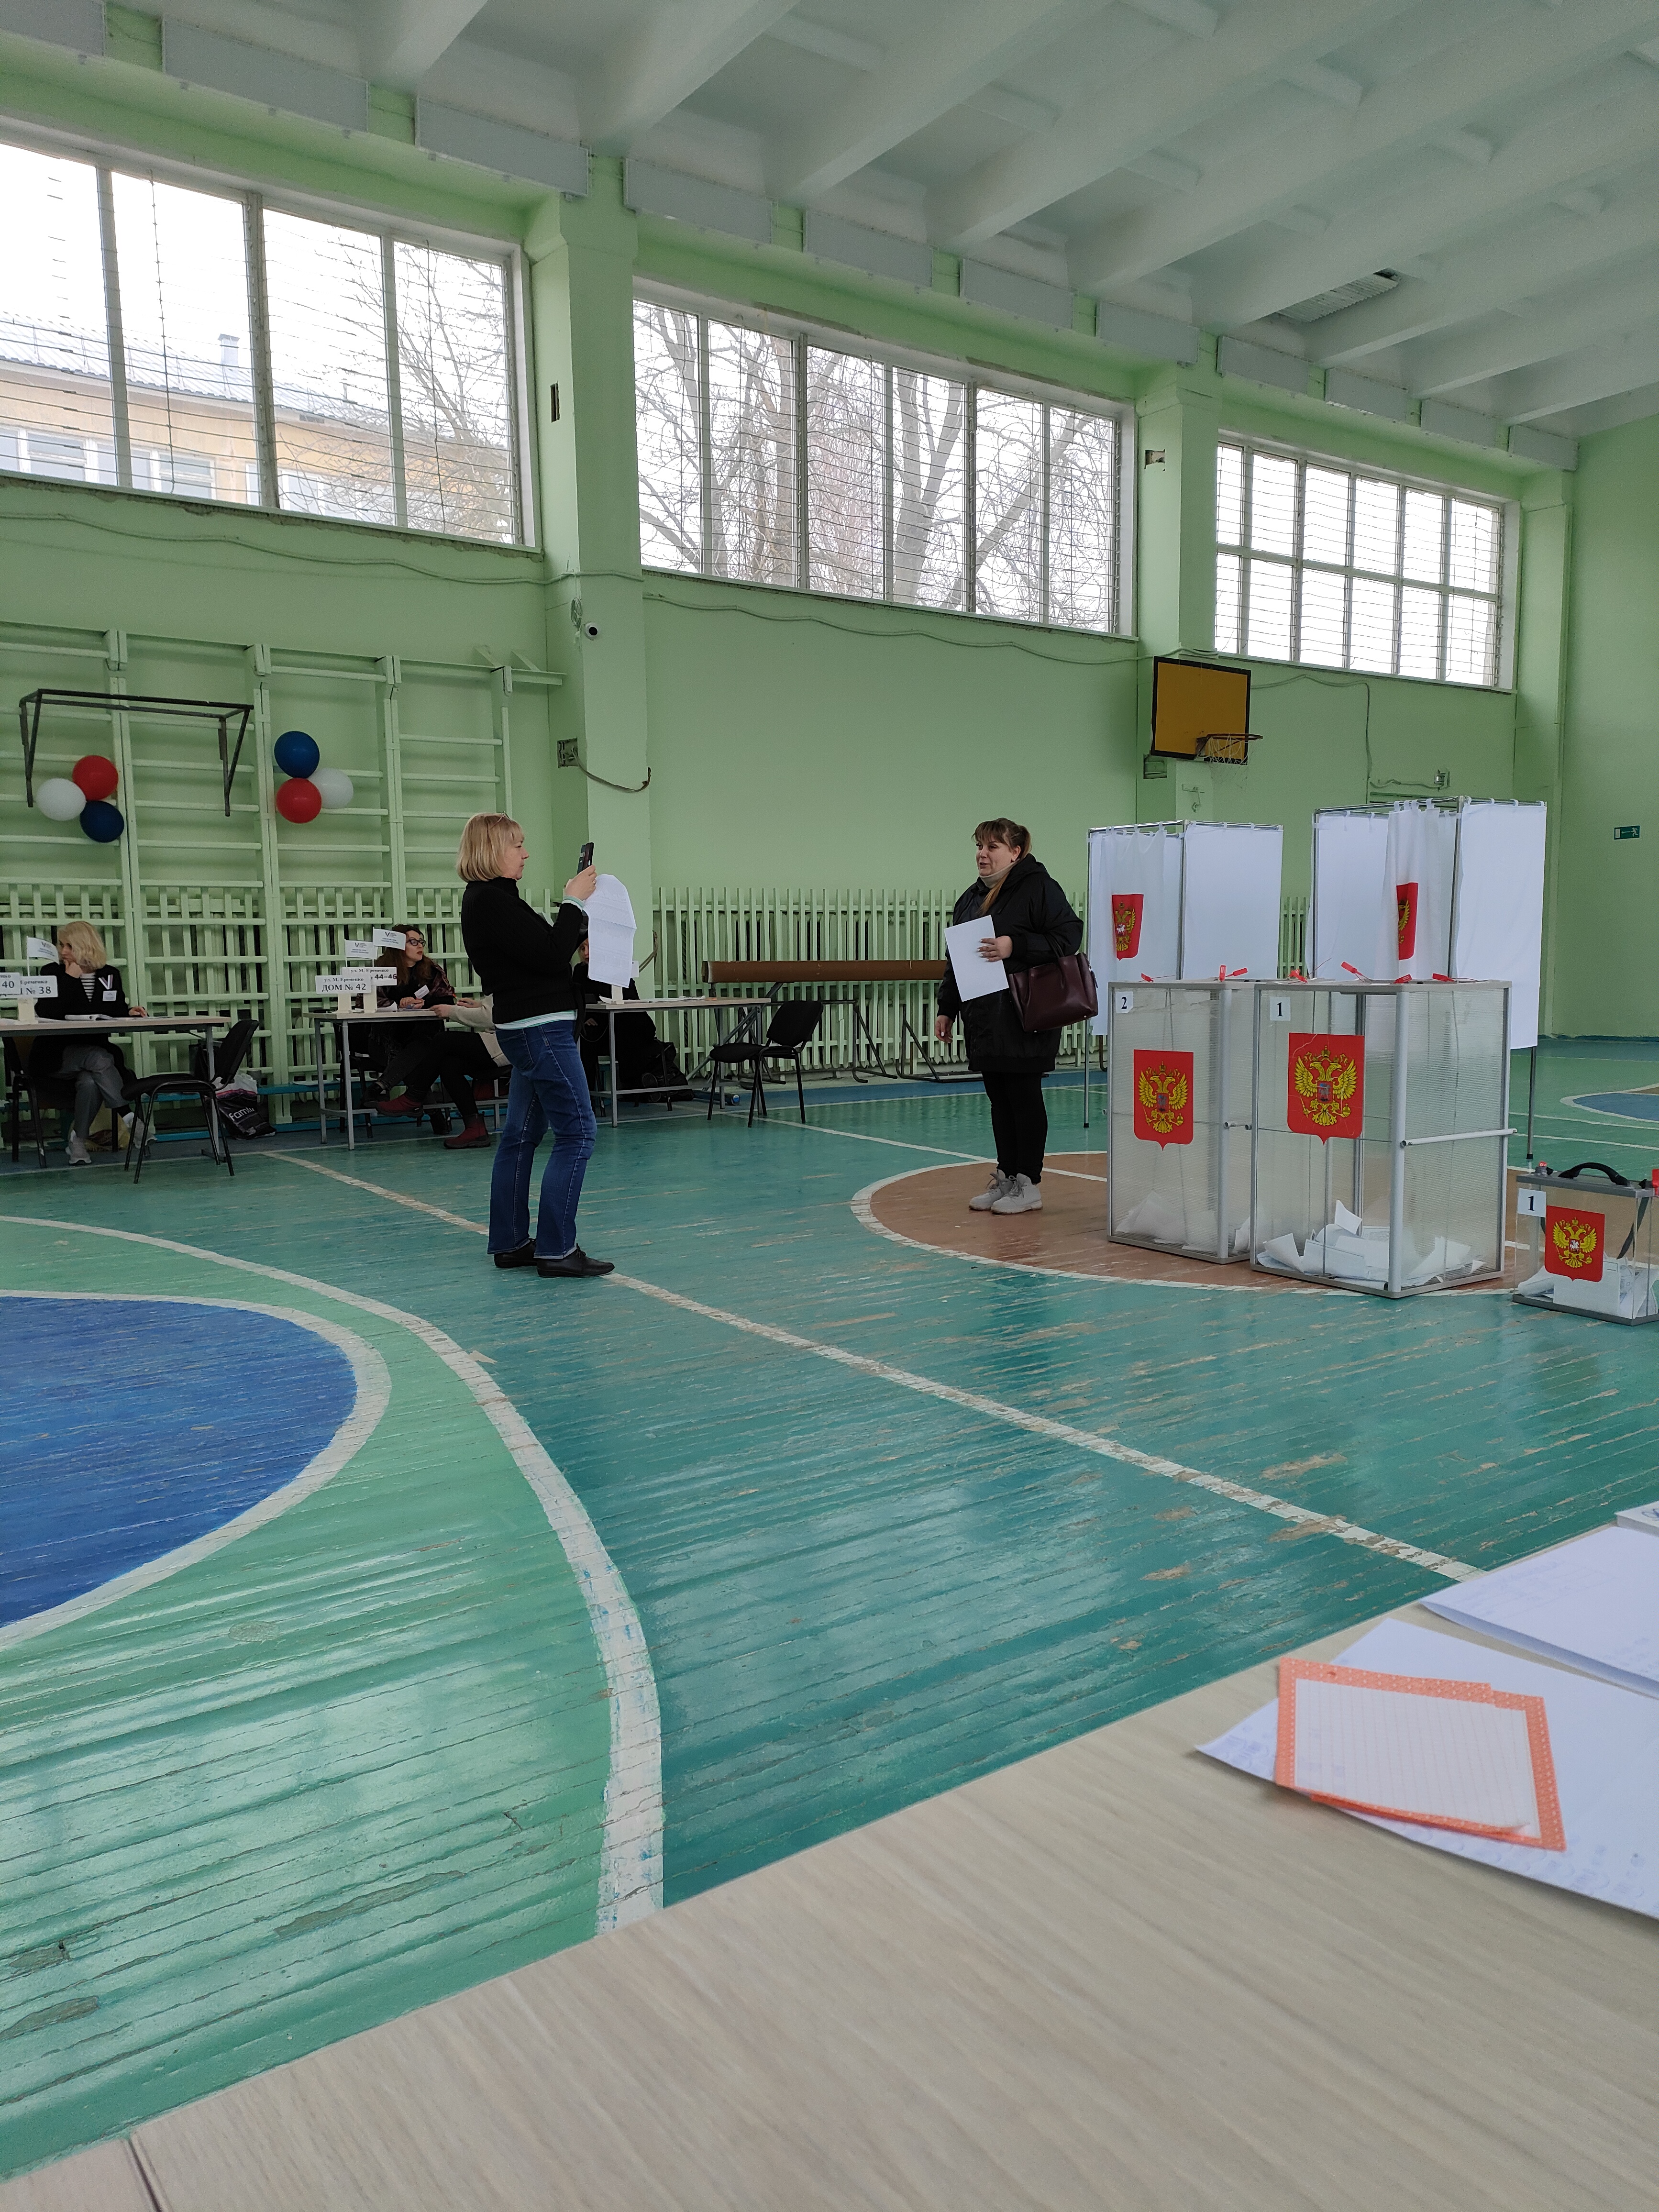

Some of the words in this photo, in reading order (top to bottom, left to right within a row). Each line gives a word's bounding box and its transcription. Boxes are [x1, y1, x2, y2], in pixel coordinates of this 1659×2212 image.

[38, 986, 52, 995] 38
[321, 984, 343, 992] ДОМ
[1121, 996, 1128, 1009] 2
[1277, 1002, 1283, 1017] 1
[1527, 1195, 1536, 1212] 1
